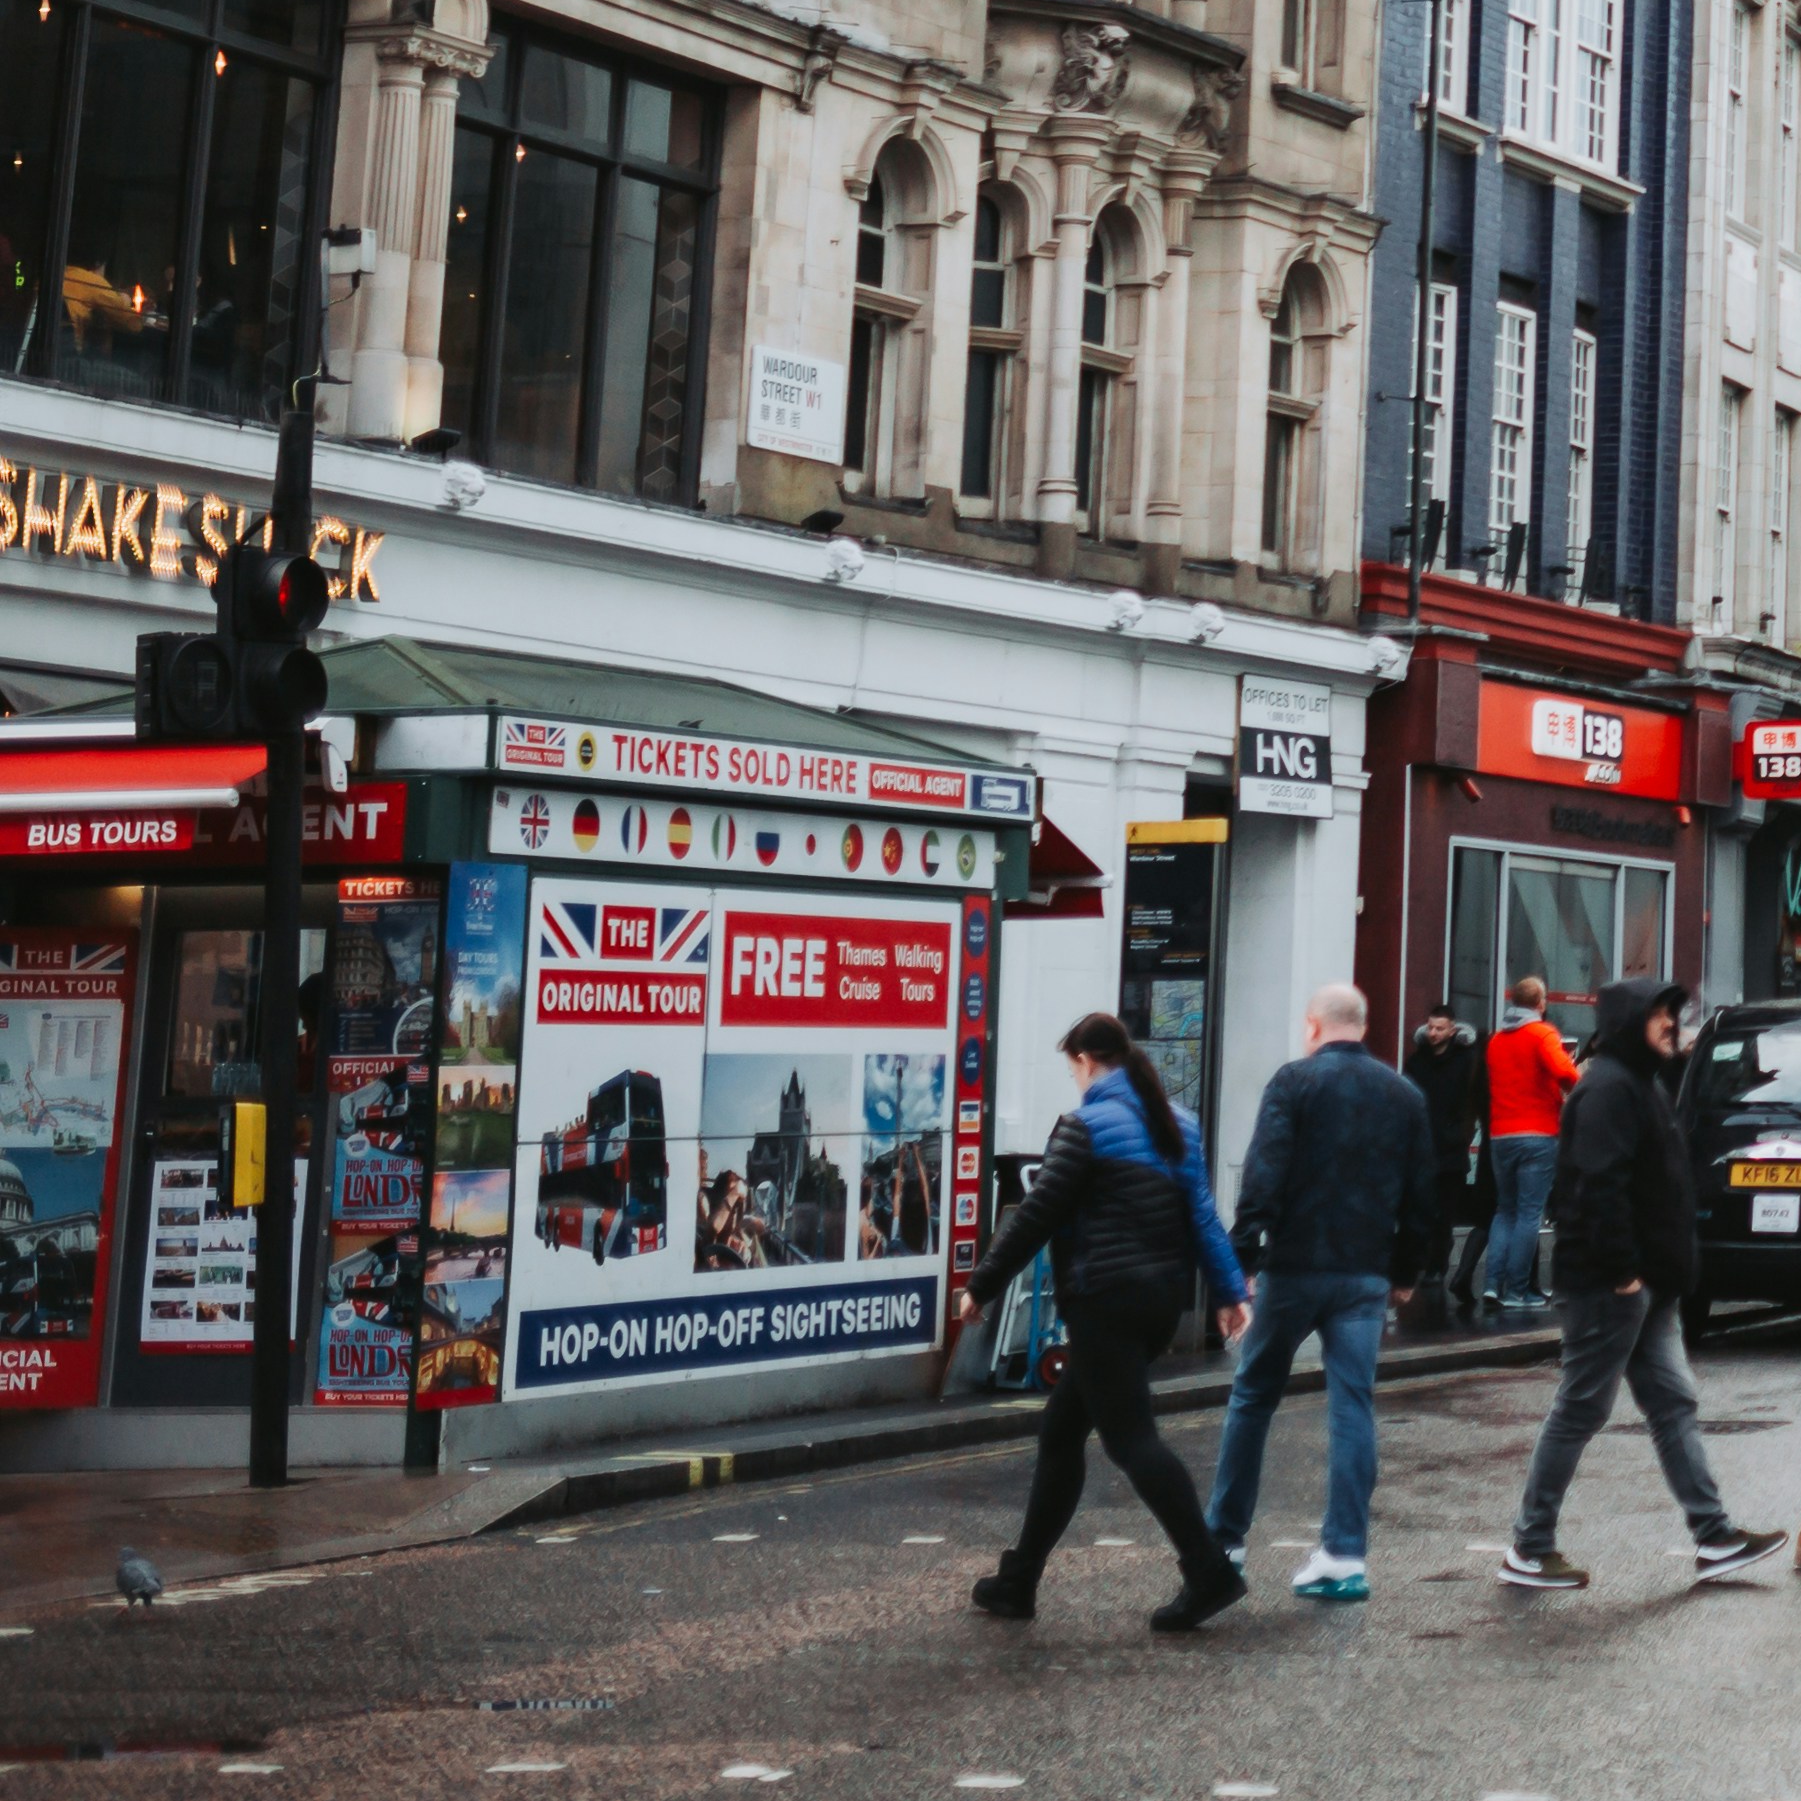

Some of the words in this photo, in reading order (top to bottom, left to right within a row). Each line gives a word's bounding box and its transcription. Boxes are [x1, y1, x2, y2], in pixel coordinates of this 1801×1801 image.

[763, 355, 818, 385] WARDOUR
[761, 379, 802, 405] STREET
[806, 390, 822, 410] W1
[1244, 688, 1289, 708] OFFICES
[1293, 694, 1305, 710] TO
[1309, 697, 1329, 712] LET
[529, 728, 544, 740] THE
[1584, 714, 1622, 758] 138
[506, 748, 542, 762] ORIGINAL
[543, 753, 564, 764] TOUR
[612, 735, 720, 781] TICKETS
[728, 747, 791, 787] SOLD
[799, 755, 857, 794] HERE
[1256, 733, 1317, 779] HNG
[1758, 756, 1801, 778] 138
[872, 769, 924, 793] OFFICIAL
[924, 775, 961, 797] AGENT
[27, 823, 82, 847] BUS
[90, 820, 178, 844] TOURS
[228, 801, 388, 844] AENT
[345, 881, 413, 896] TICKETS
[607, 918, 650, 948] THE
[25, 951, 64, 963] THE
[731, 936, 828, 997] FREE
[837, 941, 886, 967] Thames
[894, 944, 943, 974] Walking
[65, 980, 118, 994] TOUR
[542, 982, 644, 1013] ORIGINAL
[648, 985, 702, 1014] TOUR
[839, 976, 880, 1000] Cruise
[900, 978, 934, 1001] Tours
[346, 1159, 382, 1172] HOP-ON
[331, 1329, 368, 1342] HOP-ON
[540, 1316, 648, 1367] HOP-ON
[654, 1306, 765, 1354] HOP-OFF
[770, 1292, 921, 1342] SIGHTSEEING
